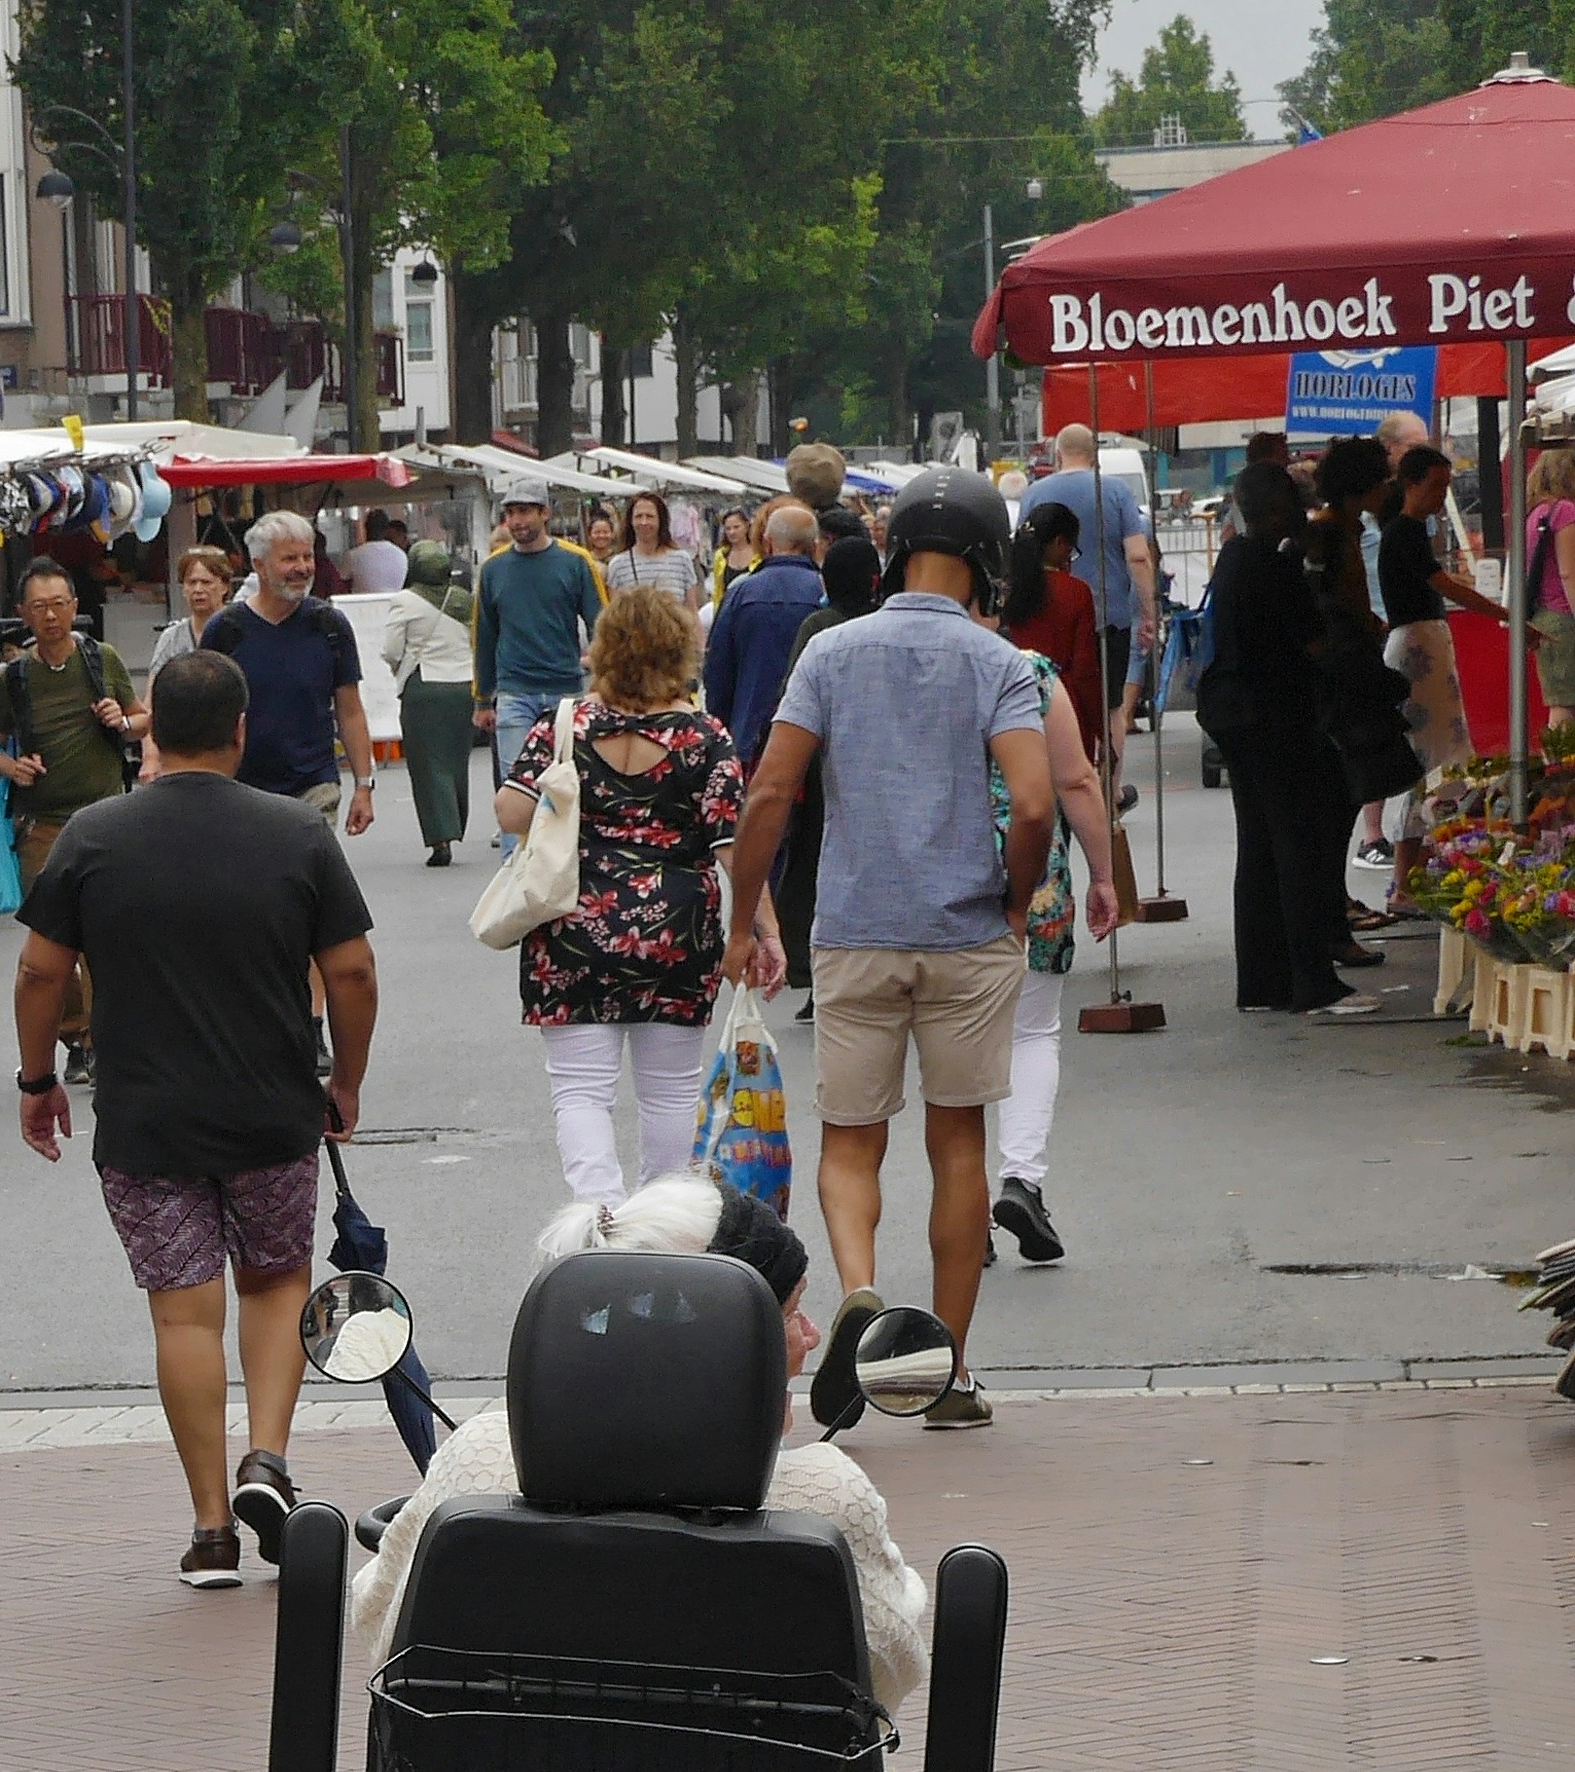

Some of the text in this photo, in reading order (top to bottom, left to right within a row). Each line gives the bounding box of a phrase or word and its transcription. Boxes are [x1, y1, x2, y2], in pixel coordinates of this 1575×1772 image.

[1050, 278, 1398, 354] Bloemenhoek
[1428, 274, 1534, 332] Piet
[1295, 371, 1416, 402] HORLOGES
